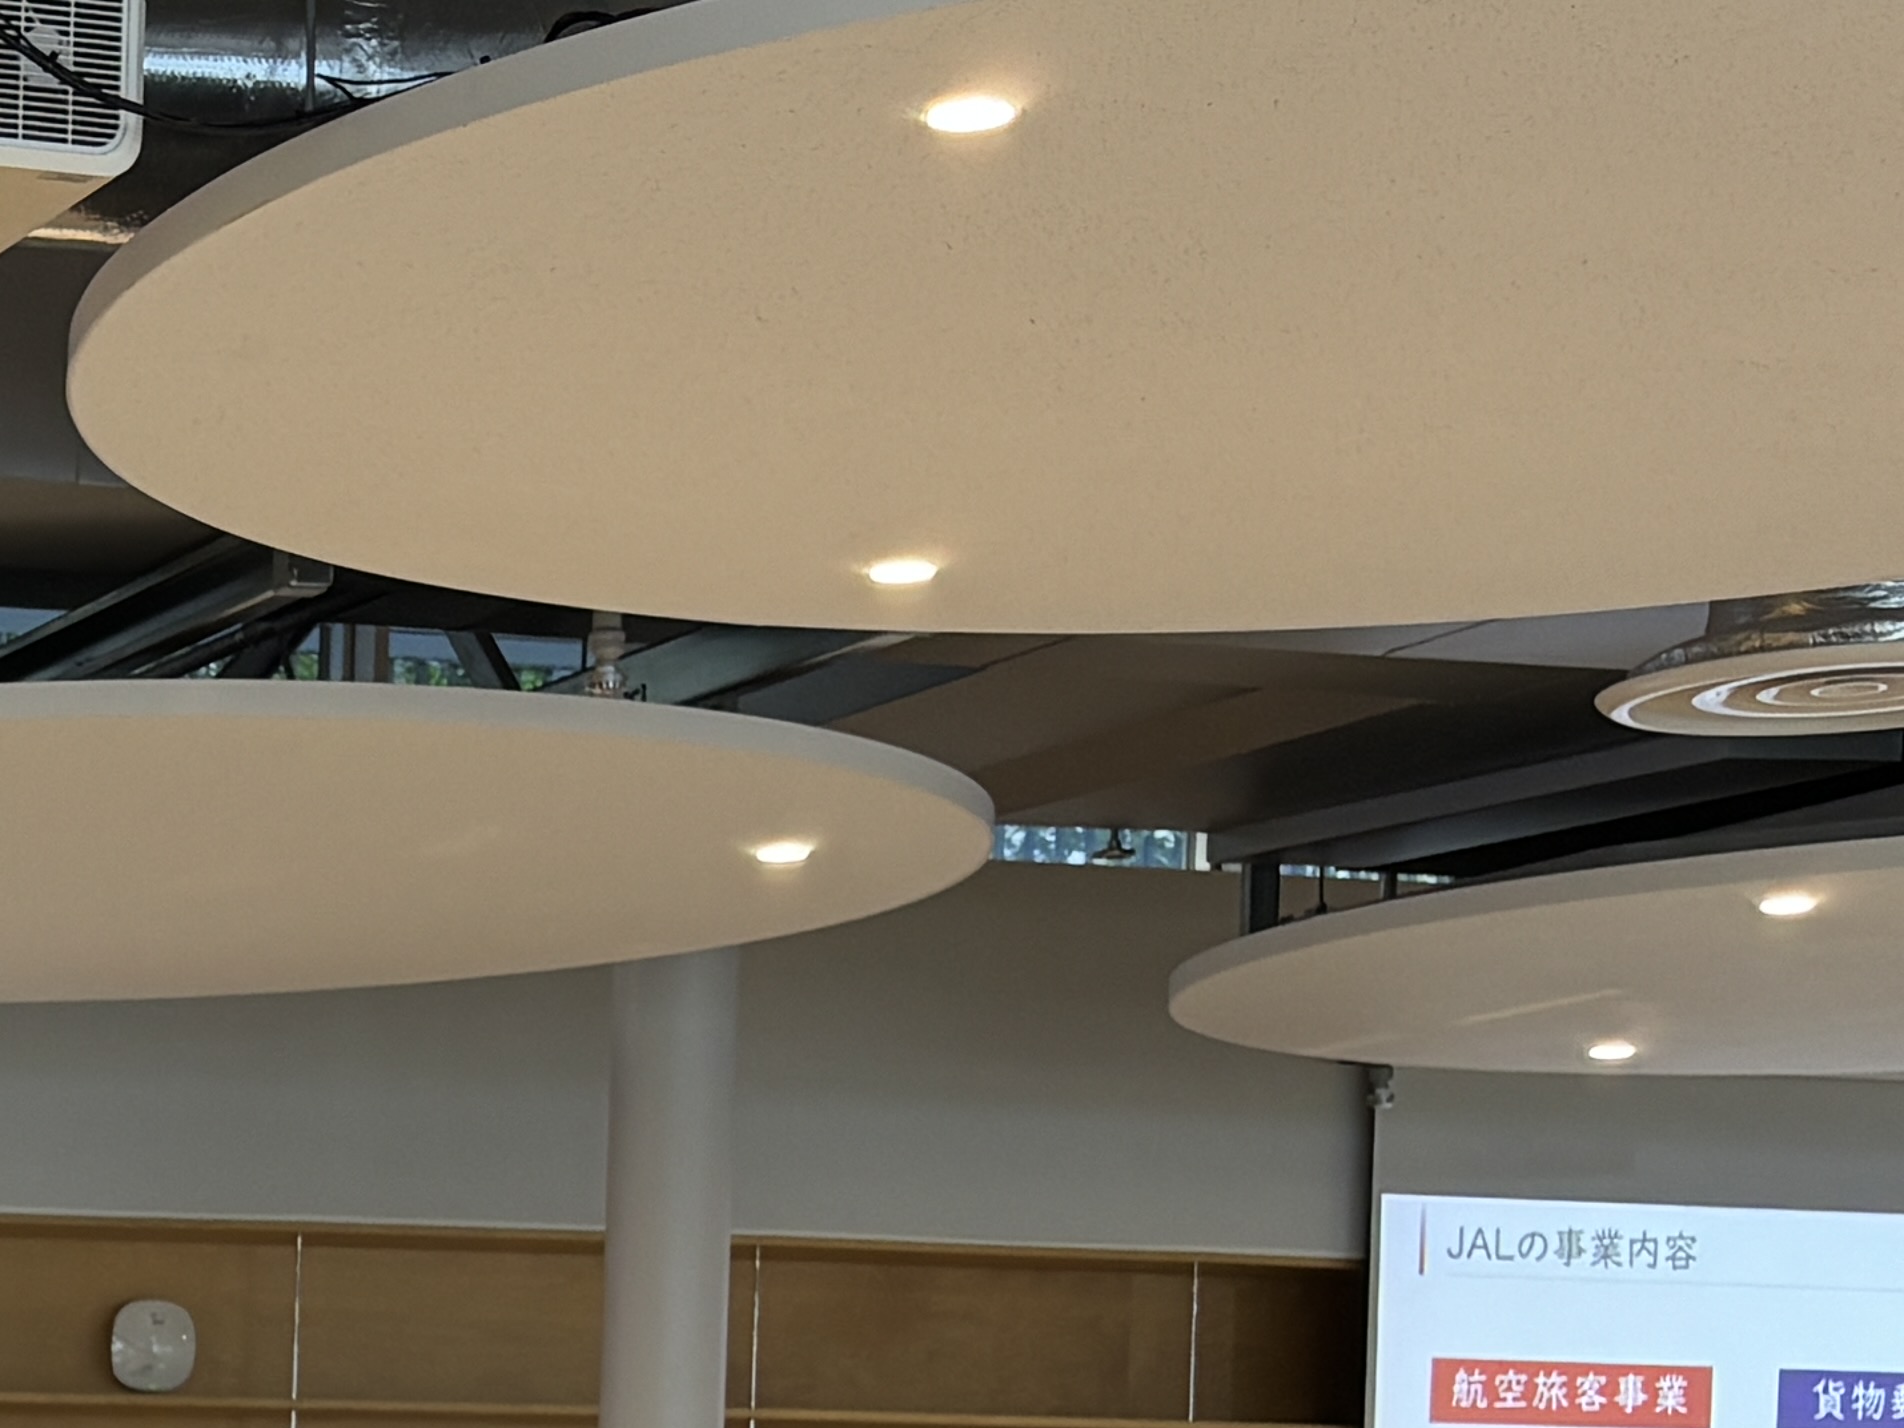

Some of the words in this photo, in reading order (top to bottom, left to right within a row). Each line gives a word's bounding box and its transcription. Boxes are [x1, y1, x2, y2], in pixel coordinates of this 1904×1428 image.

[1446, 1226, 1698, 1271] JALの事業内容
[1450, 1364, 1690, 1416] 航空旅客事業
